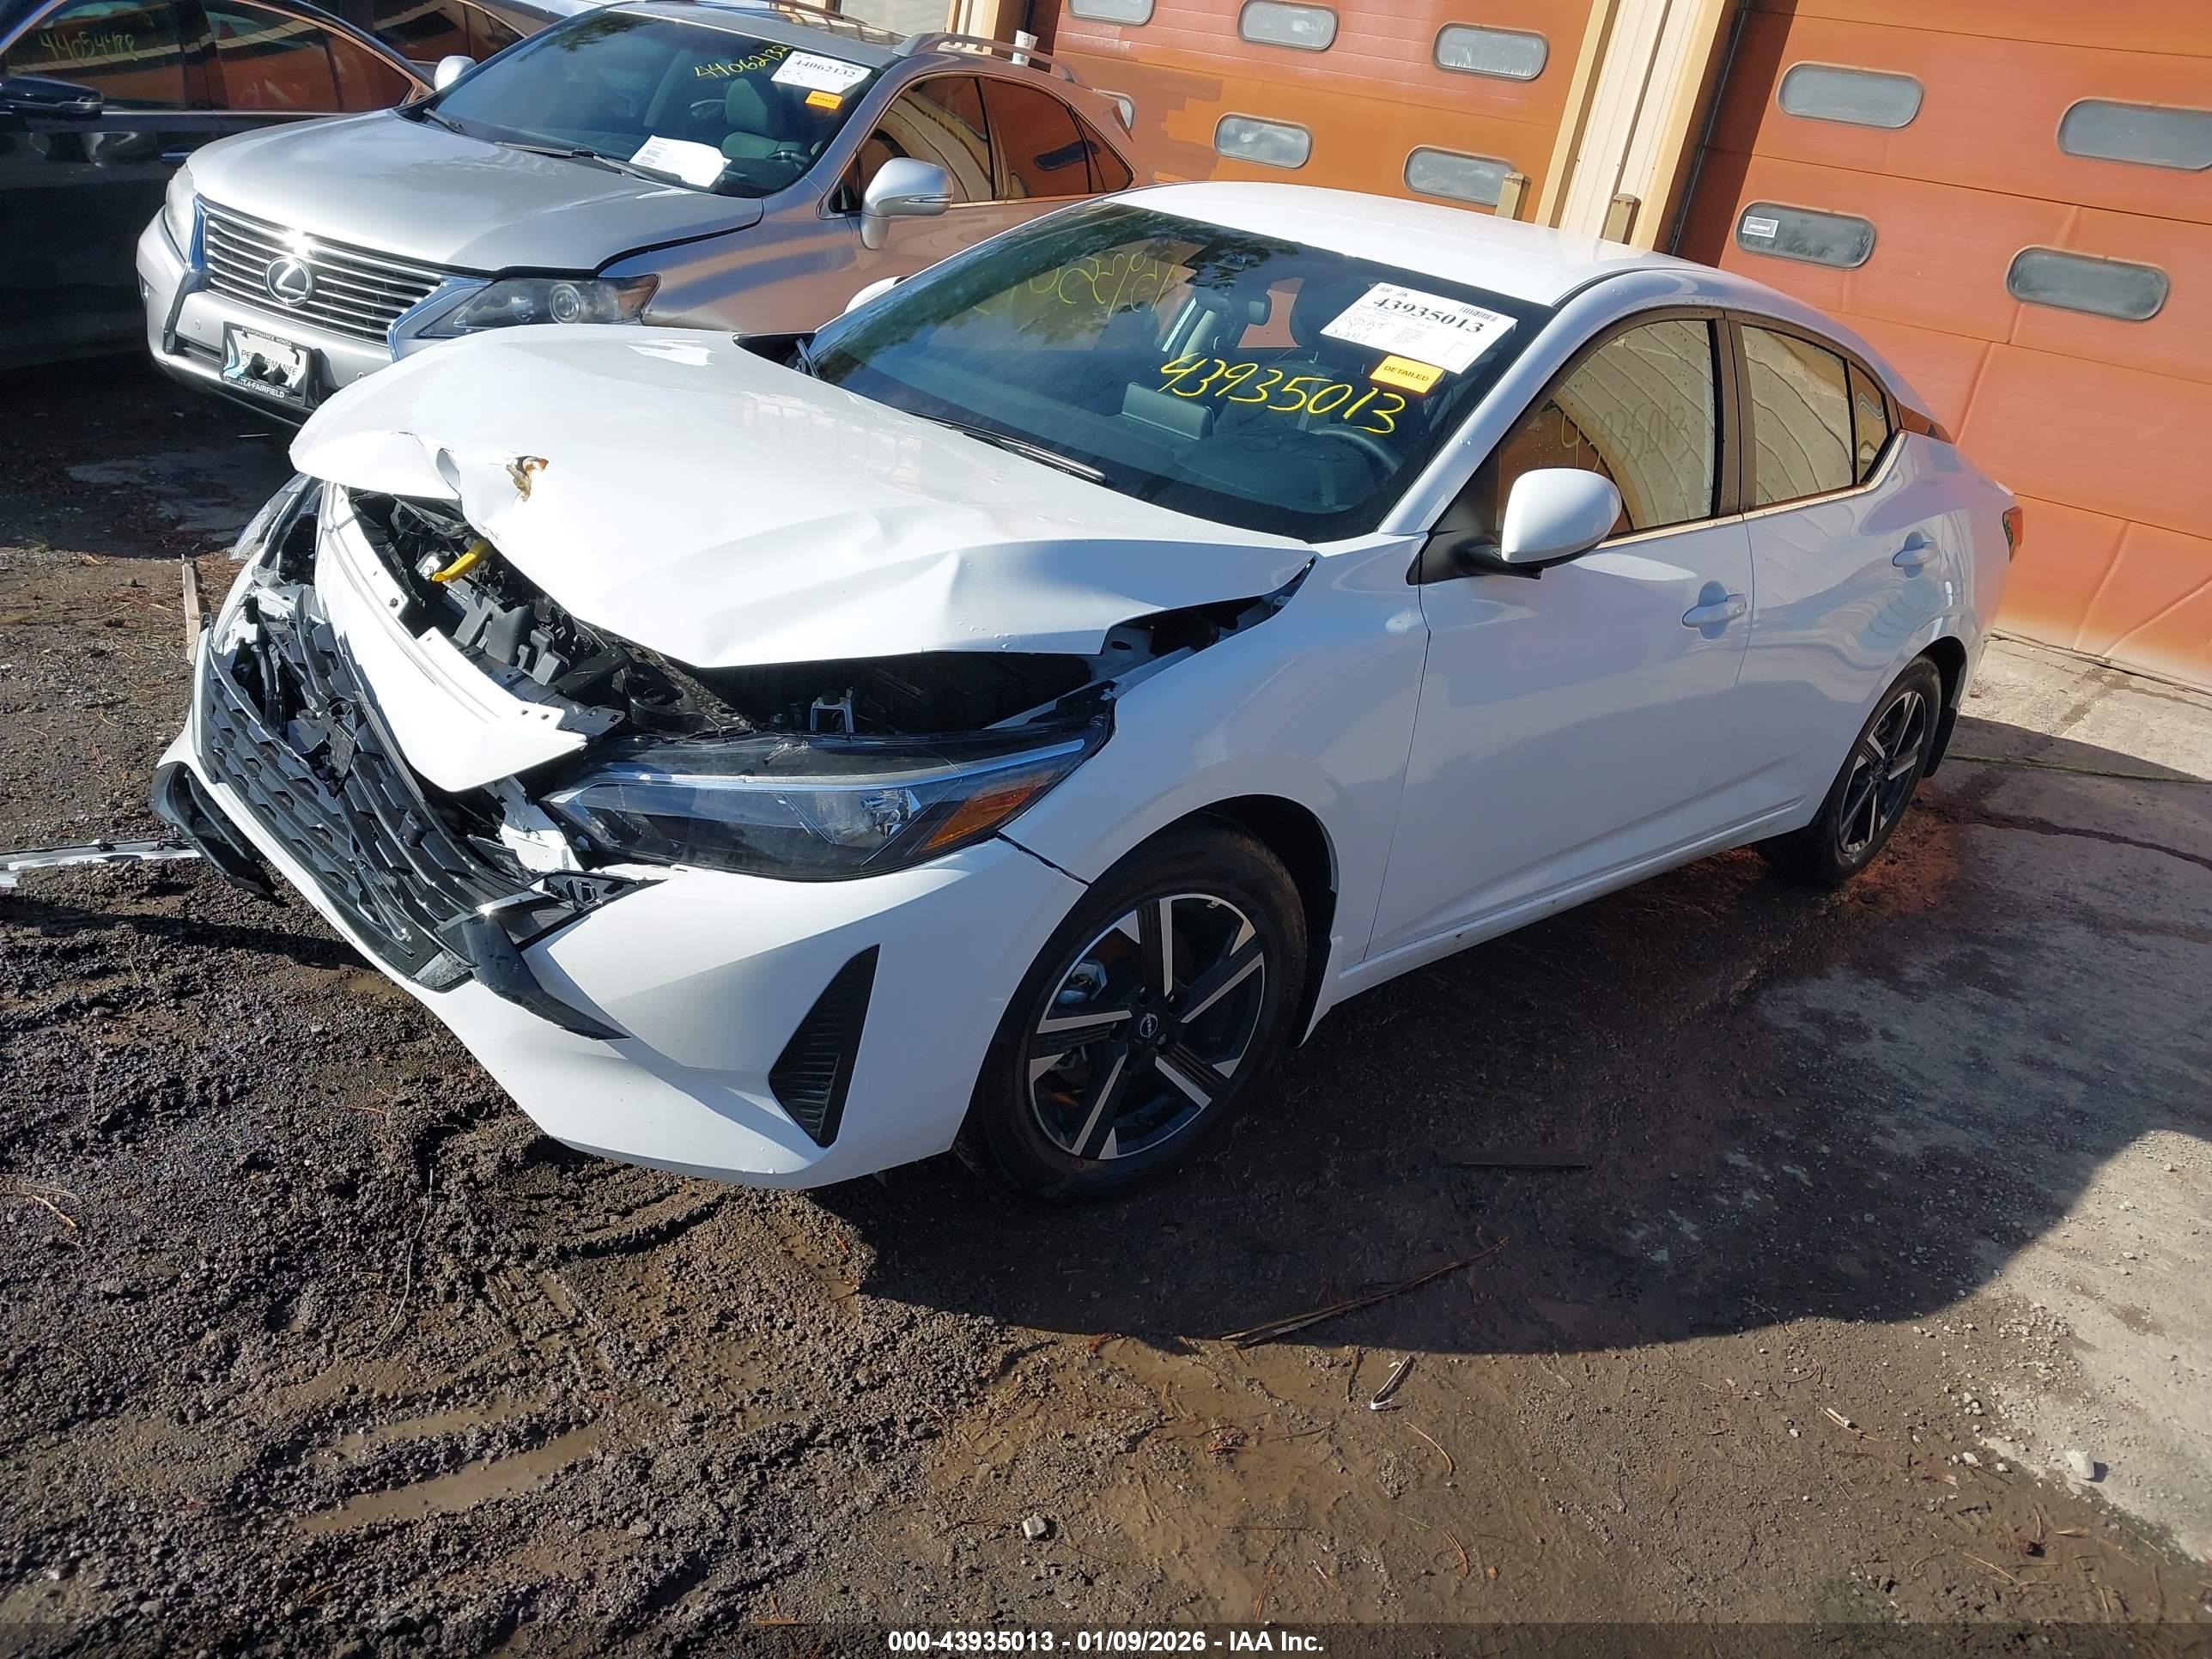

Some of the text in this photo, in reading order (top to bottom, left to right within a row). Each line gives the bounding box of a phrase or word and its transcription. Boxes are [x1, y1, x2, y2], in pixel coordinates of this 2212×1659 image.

[694, 45, 793, 79] 44062132
[793, 59, 856, 77] 44062132
[1374, 297, 1485, 333] 43935013
[1382, 365, 1430, 382] DETAILED
[1157, 352, 1406, 434] 43935013
